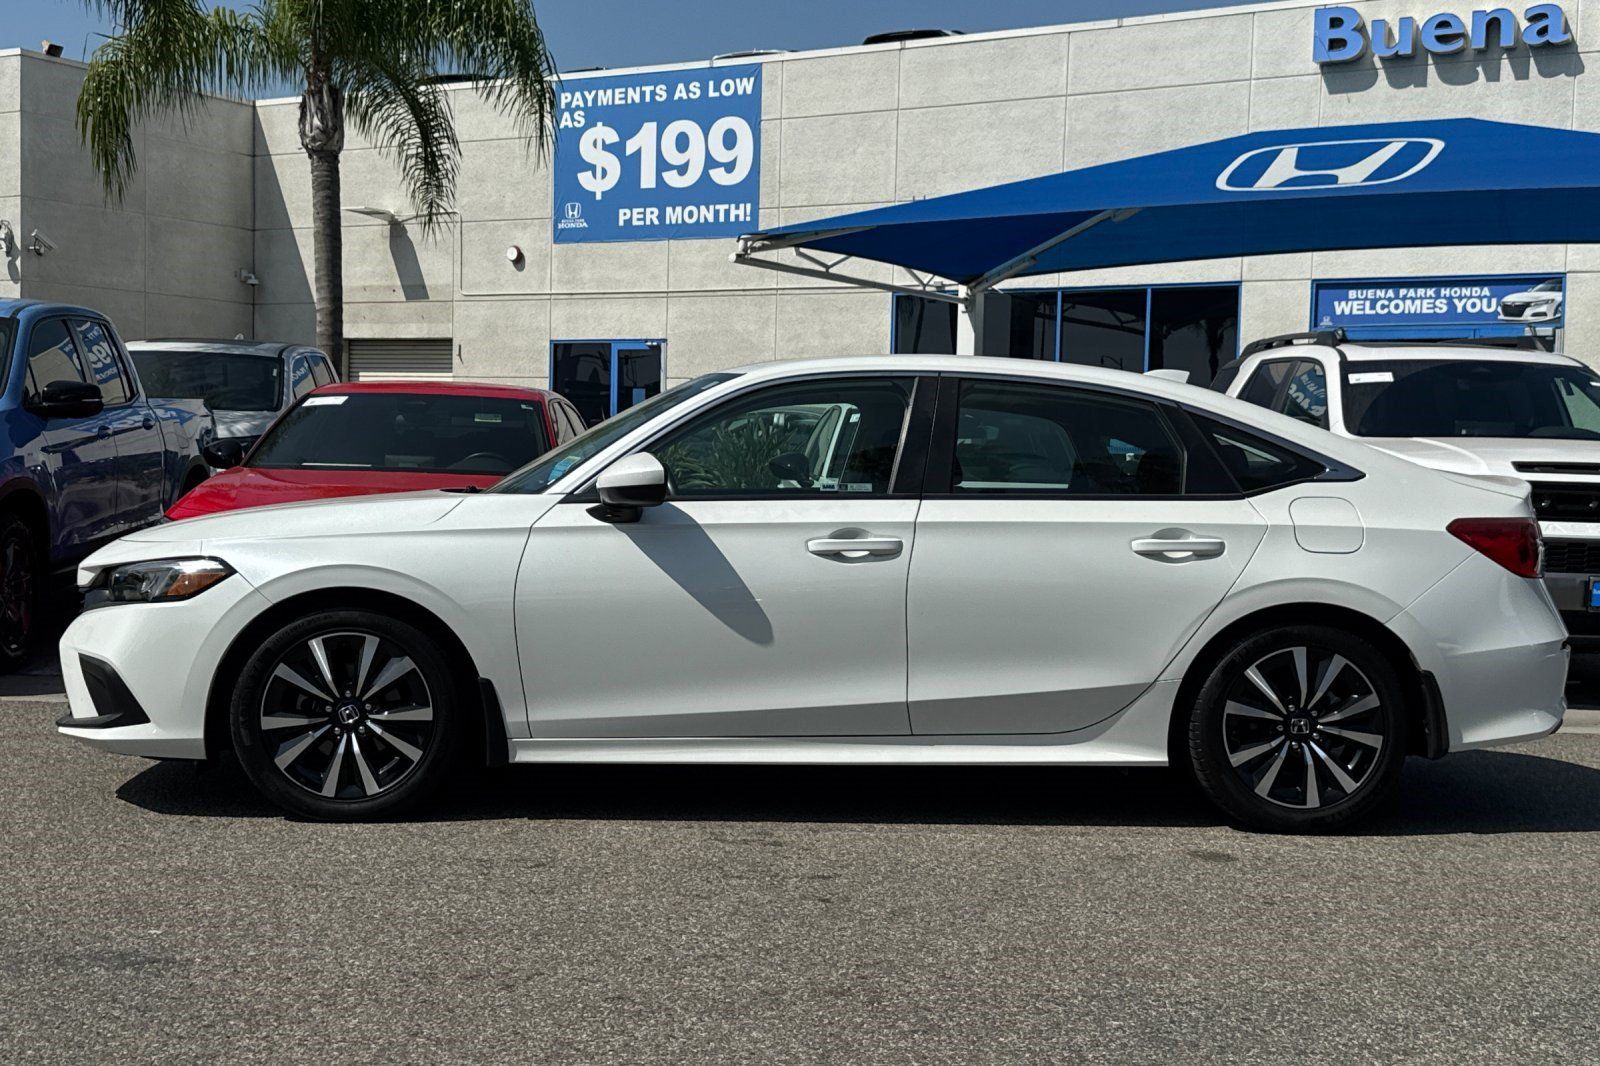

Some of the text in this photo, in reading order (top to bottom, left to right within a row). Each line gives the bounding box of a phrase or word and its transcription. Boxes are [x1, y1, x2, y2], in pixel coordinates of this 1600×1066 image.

[1312, 3, 1571, 64] Buena
[560, 77, 755, 109] PAYMENTS AS LOW
[559, 110, 586, 129] AS
[576, 115, 754, 201] $199
[618, 203, 751, 226] PER MONTH!
[1348, 287, 1491, 299] BUENA PARK HONDA
[1333, 297, 1498, 315] WELCOMES YOU
